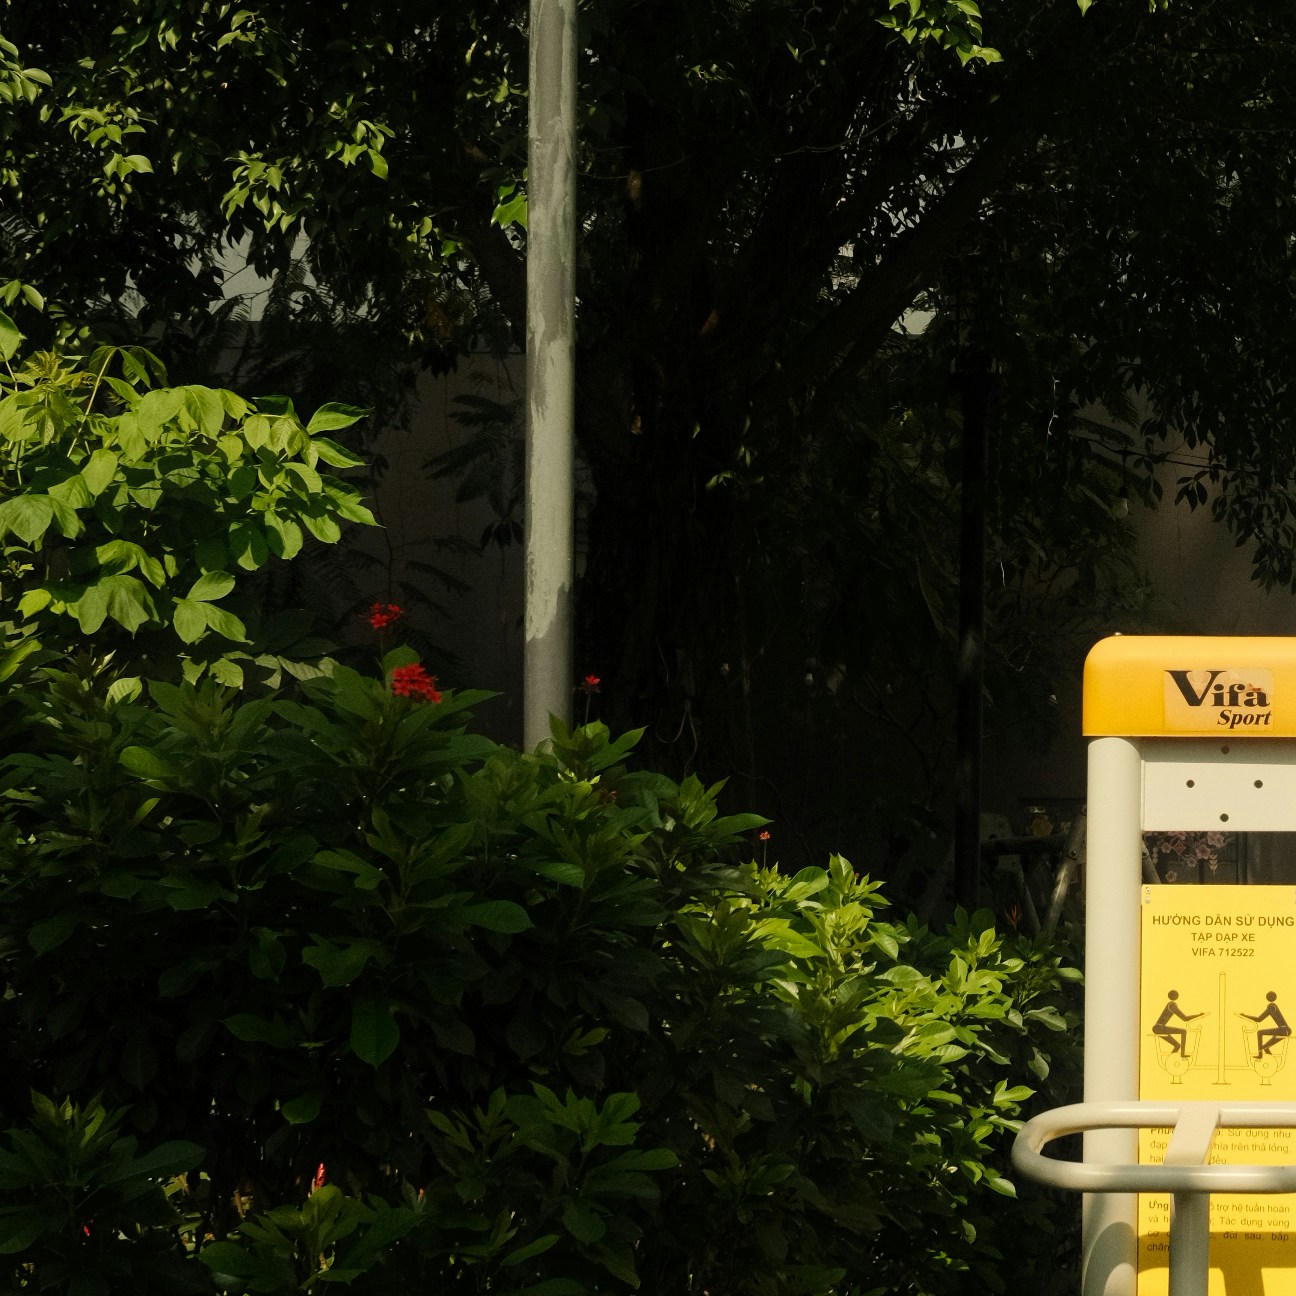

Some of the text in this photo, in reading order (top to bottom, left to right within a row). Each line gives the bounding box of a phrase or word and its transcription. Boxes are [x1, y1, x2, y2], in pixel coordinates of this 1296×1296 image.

[1164, 670, 1270, 707] Vifa
[1217, 709, 1272, 729] Sport
[1152, 912, 1295, 929] HƯỚNG DẪN SỬ DỤNG
[1241, 933, 1256, 942] XE
[1191, 947, 1255, 957] VIFA 712522
[1220, 1215, 1236, 1225] Tác
[1240, 1216, 1263, 1228] dụng
